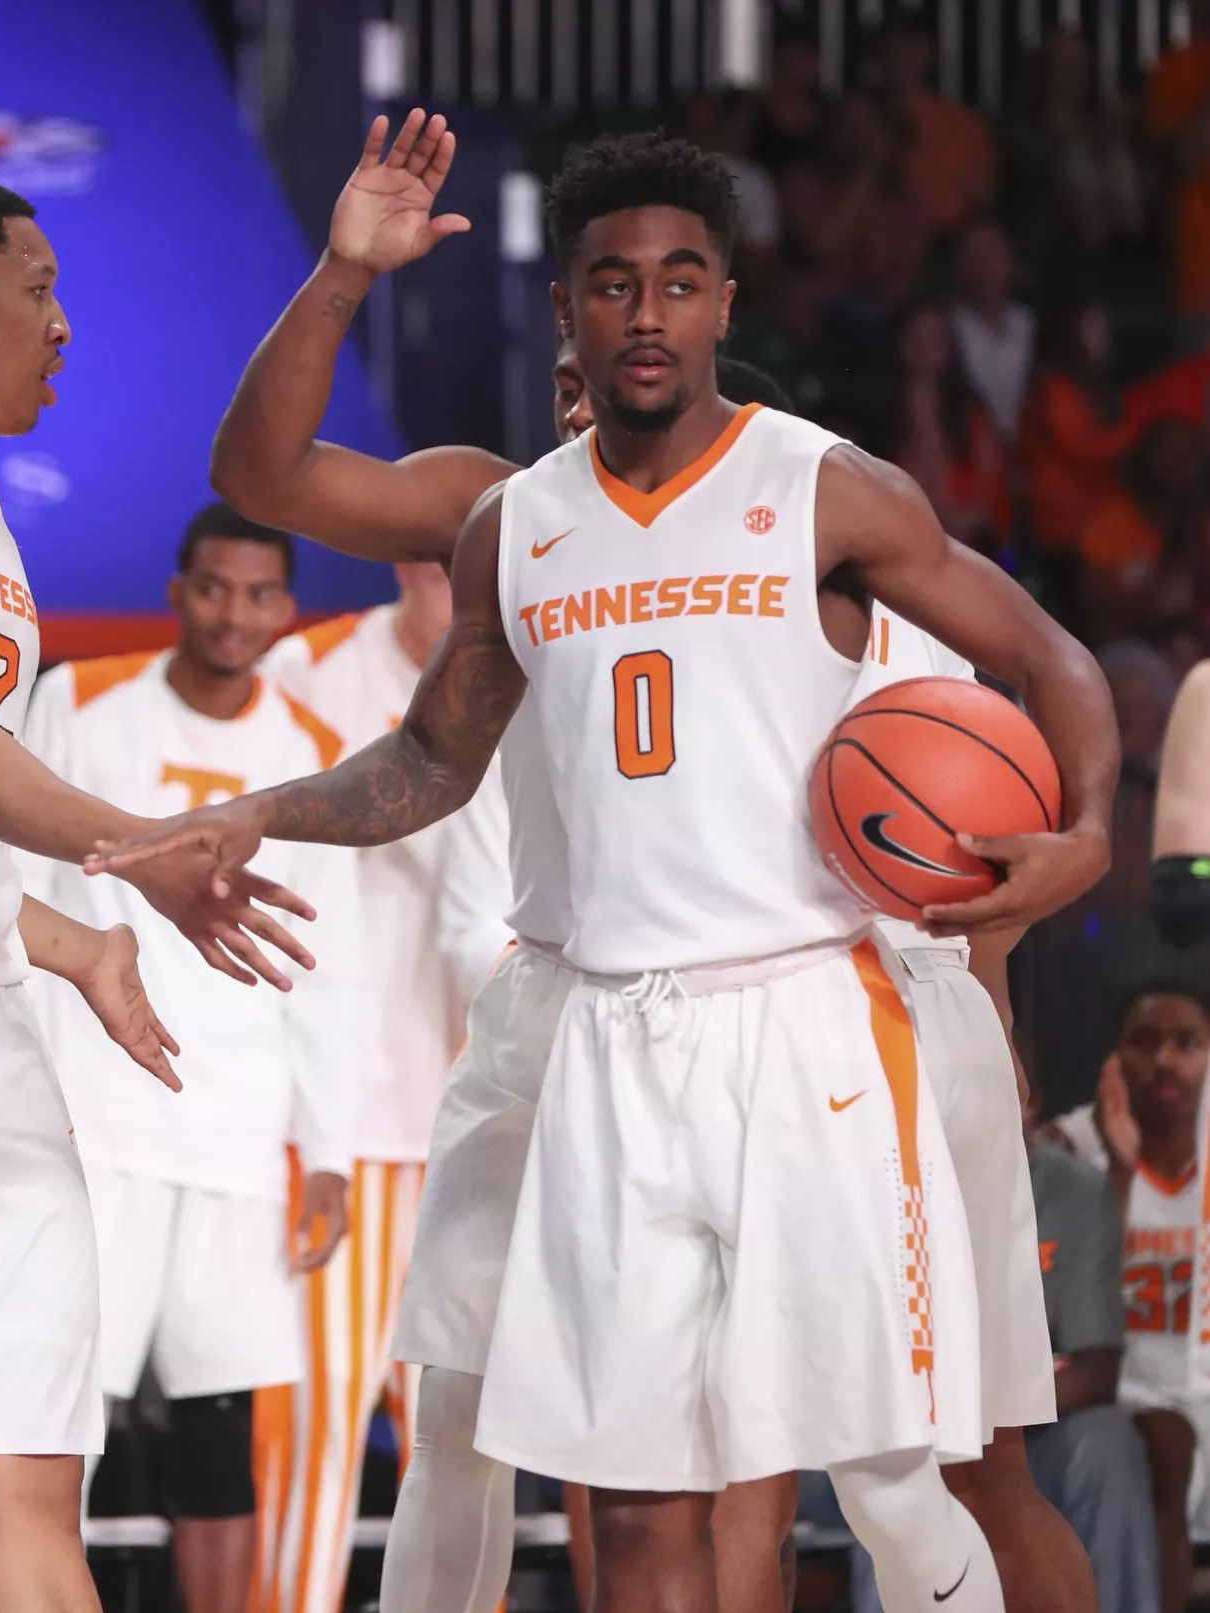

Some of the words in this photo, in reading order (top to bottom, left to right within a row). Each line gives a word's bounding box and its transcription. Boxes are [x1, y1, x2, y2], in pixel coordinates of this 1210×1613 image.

[746, 508, 775, 532] SEC
[518, 573, 791, 648] TENNESSEE
[611, 649, 677, 780] 0
